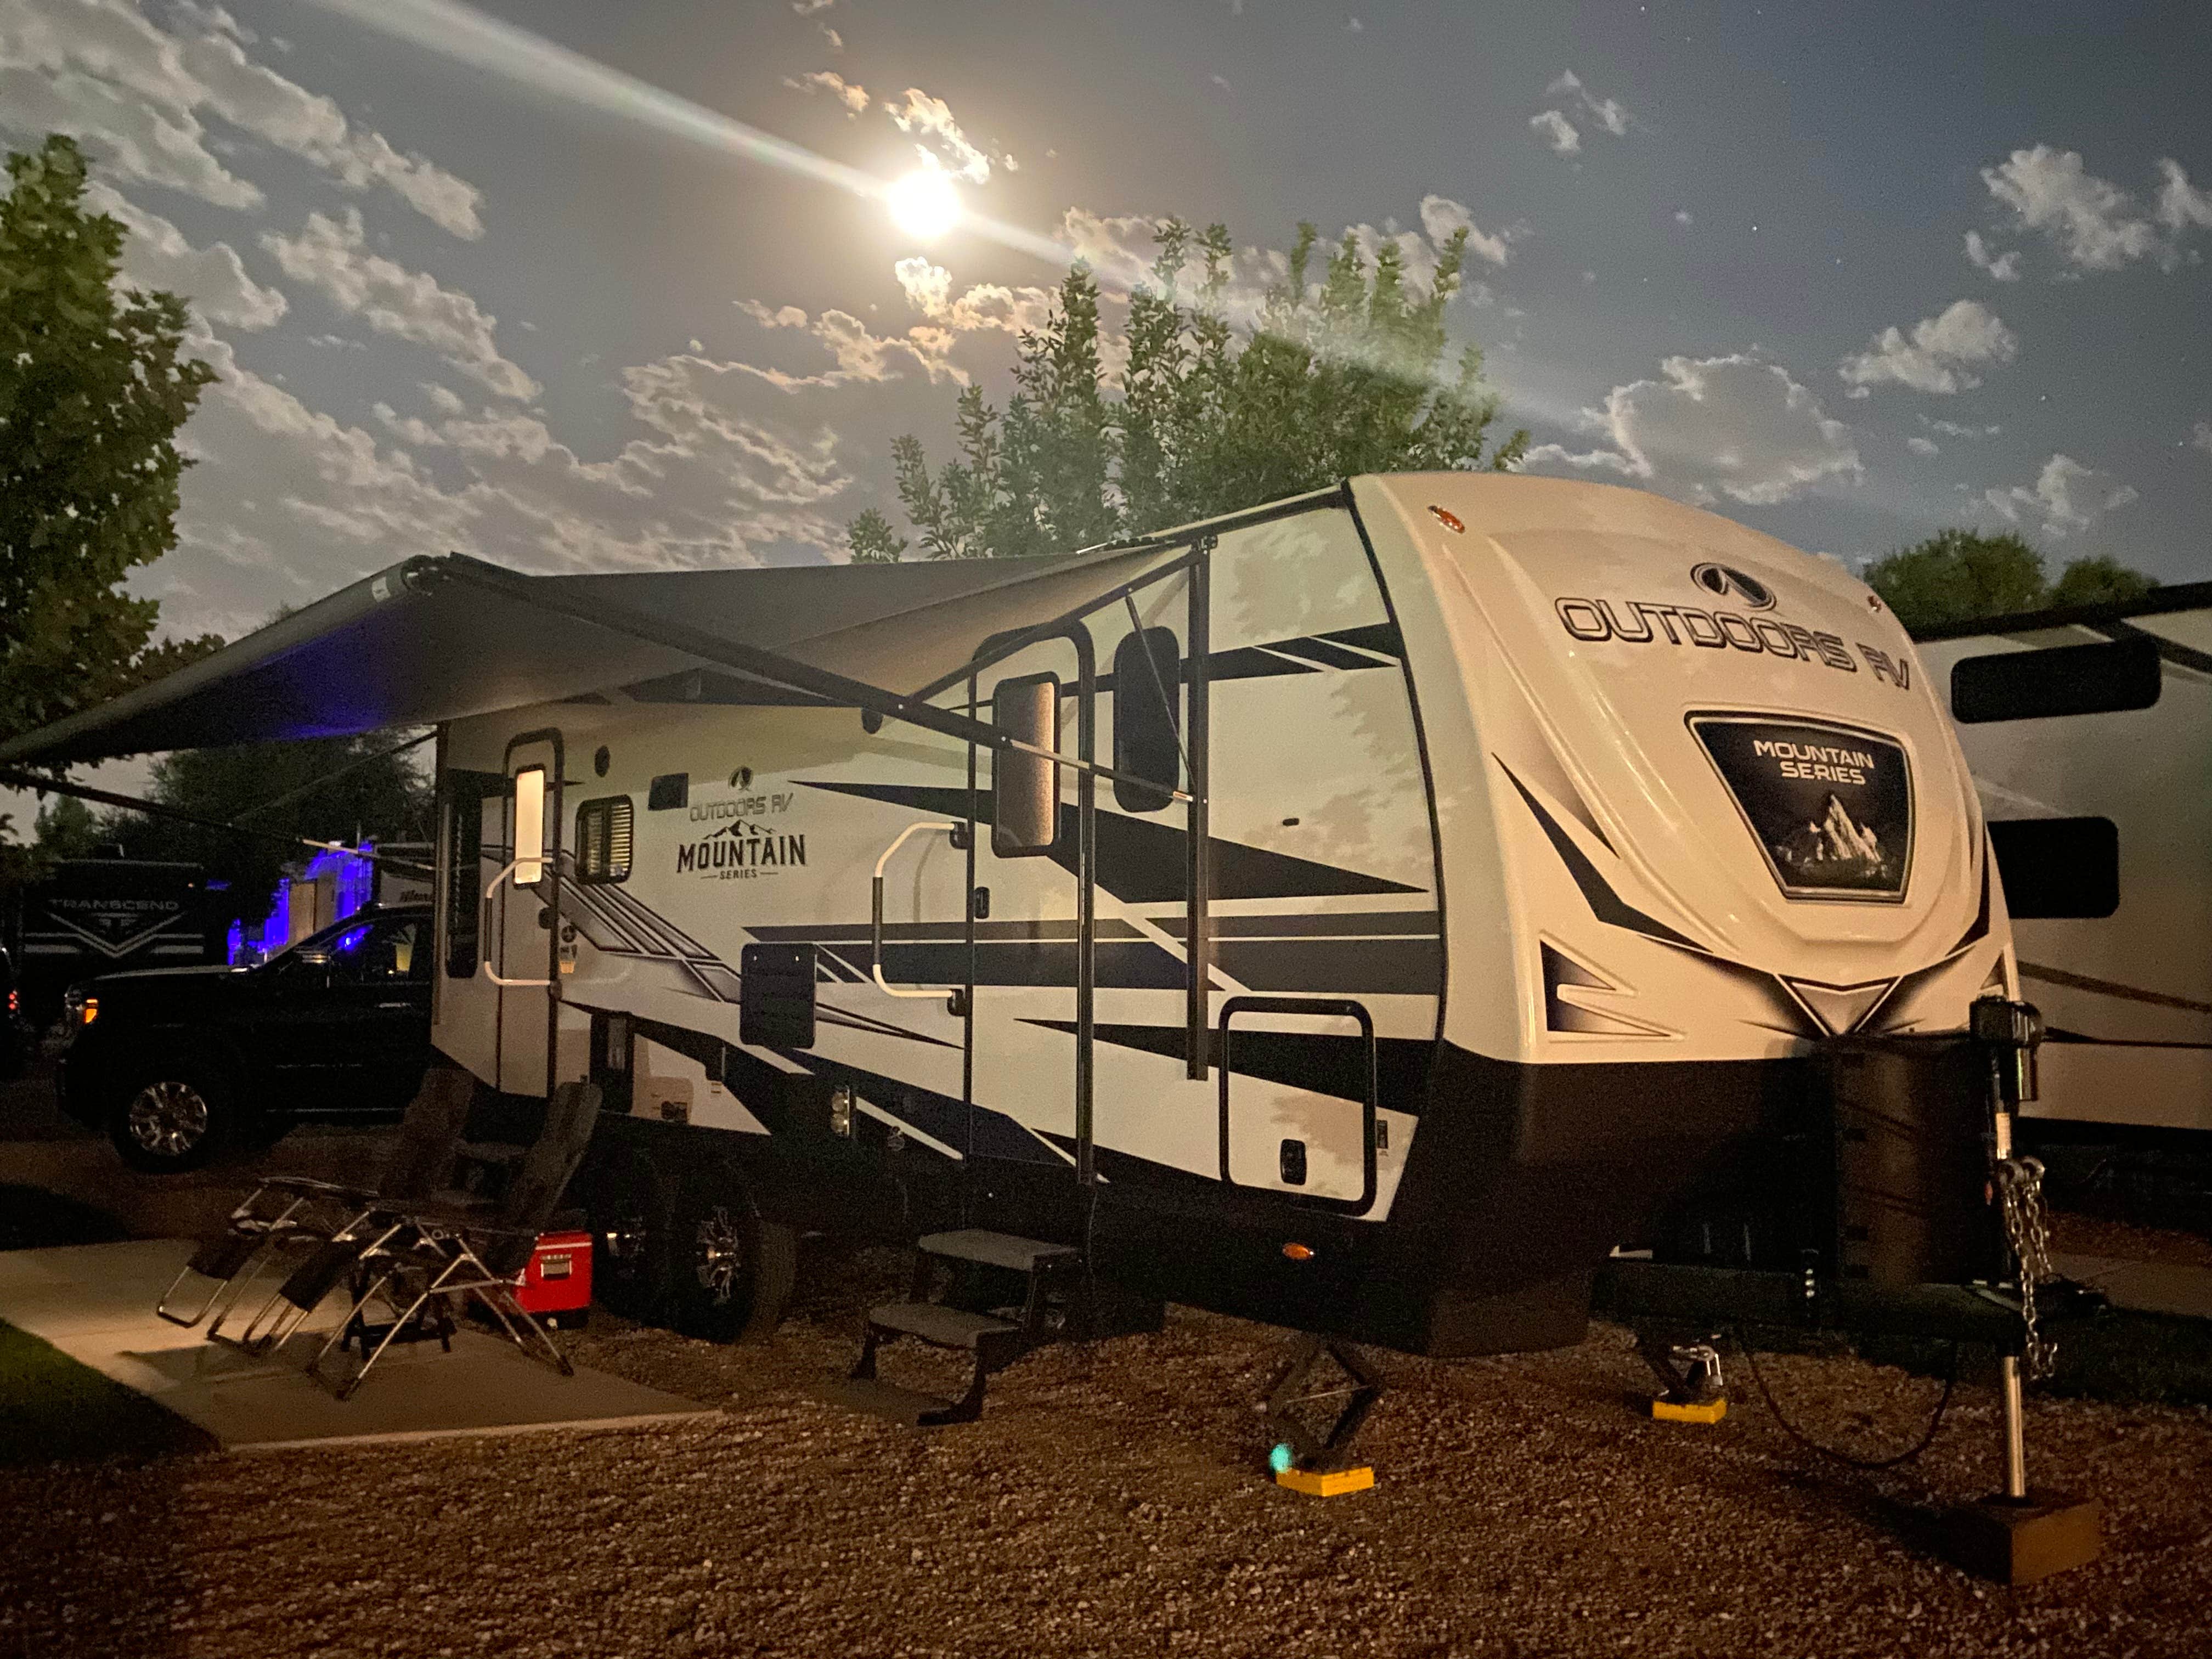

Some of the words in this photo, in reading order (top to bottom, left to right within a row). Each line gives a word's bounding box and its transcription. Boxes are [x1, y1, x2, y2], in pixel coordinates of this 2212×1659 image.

[1555, 597, 1857, 673] OUTDOORS
[1855, 642, 1909, 690] RV
[1753, 740, 1874, 769] MOUNTAIN
[1780, 761, 1866, 785] SERIES
[690, 797, 766, 822] OUTDOORS
[771, 793, 793, 813] RV
[677, 834, 806, 873] MOUNTAIN
[720, 869, 757, 880] SERIES
[48, 899, 179, 911] TRANSCEND
